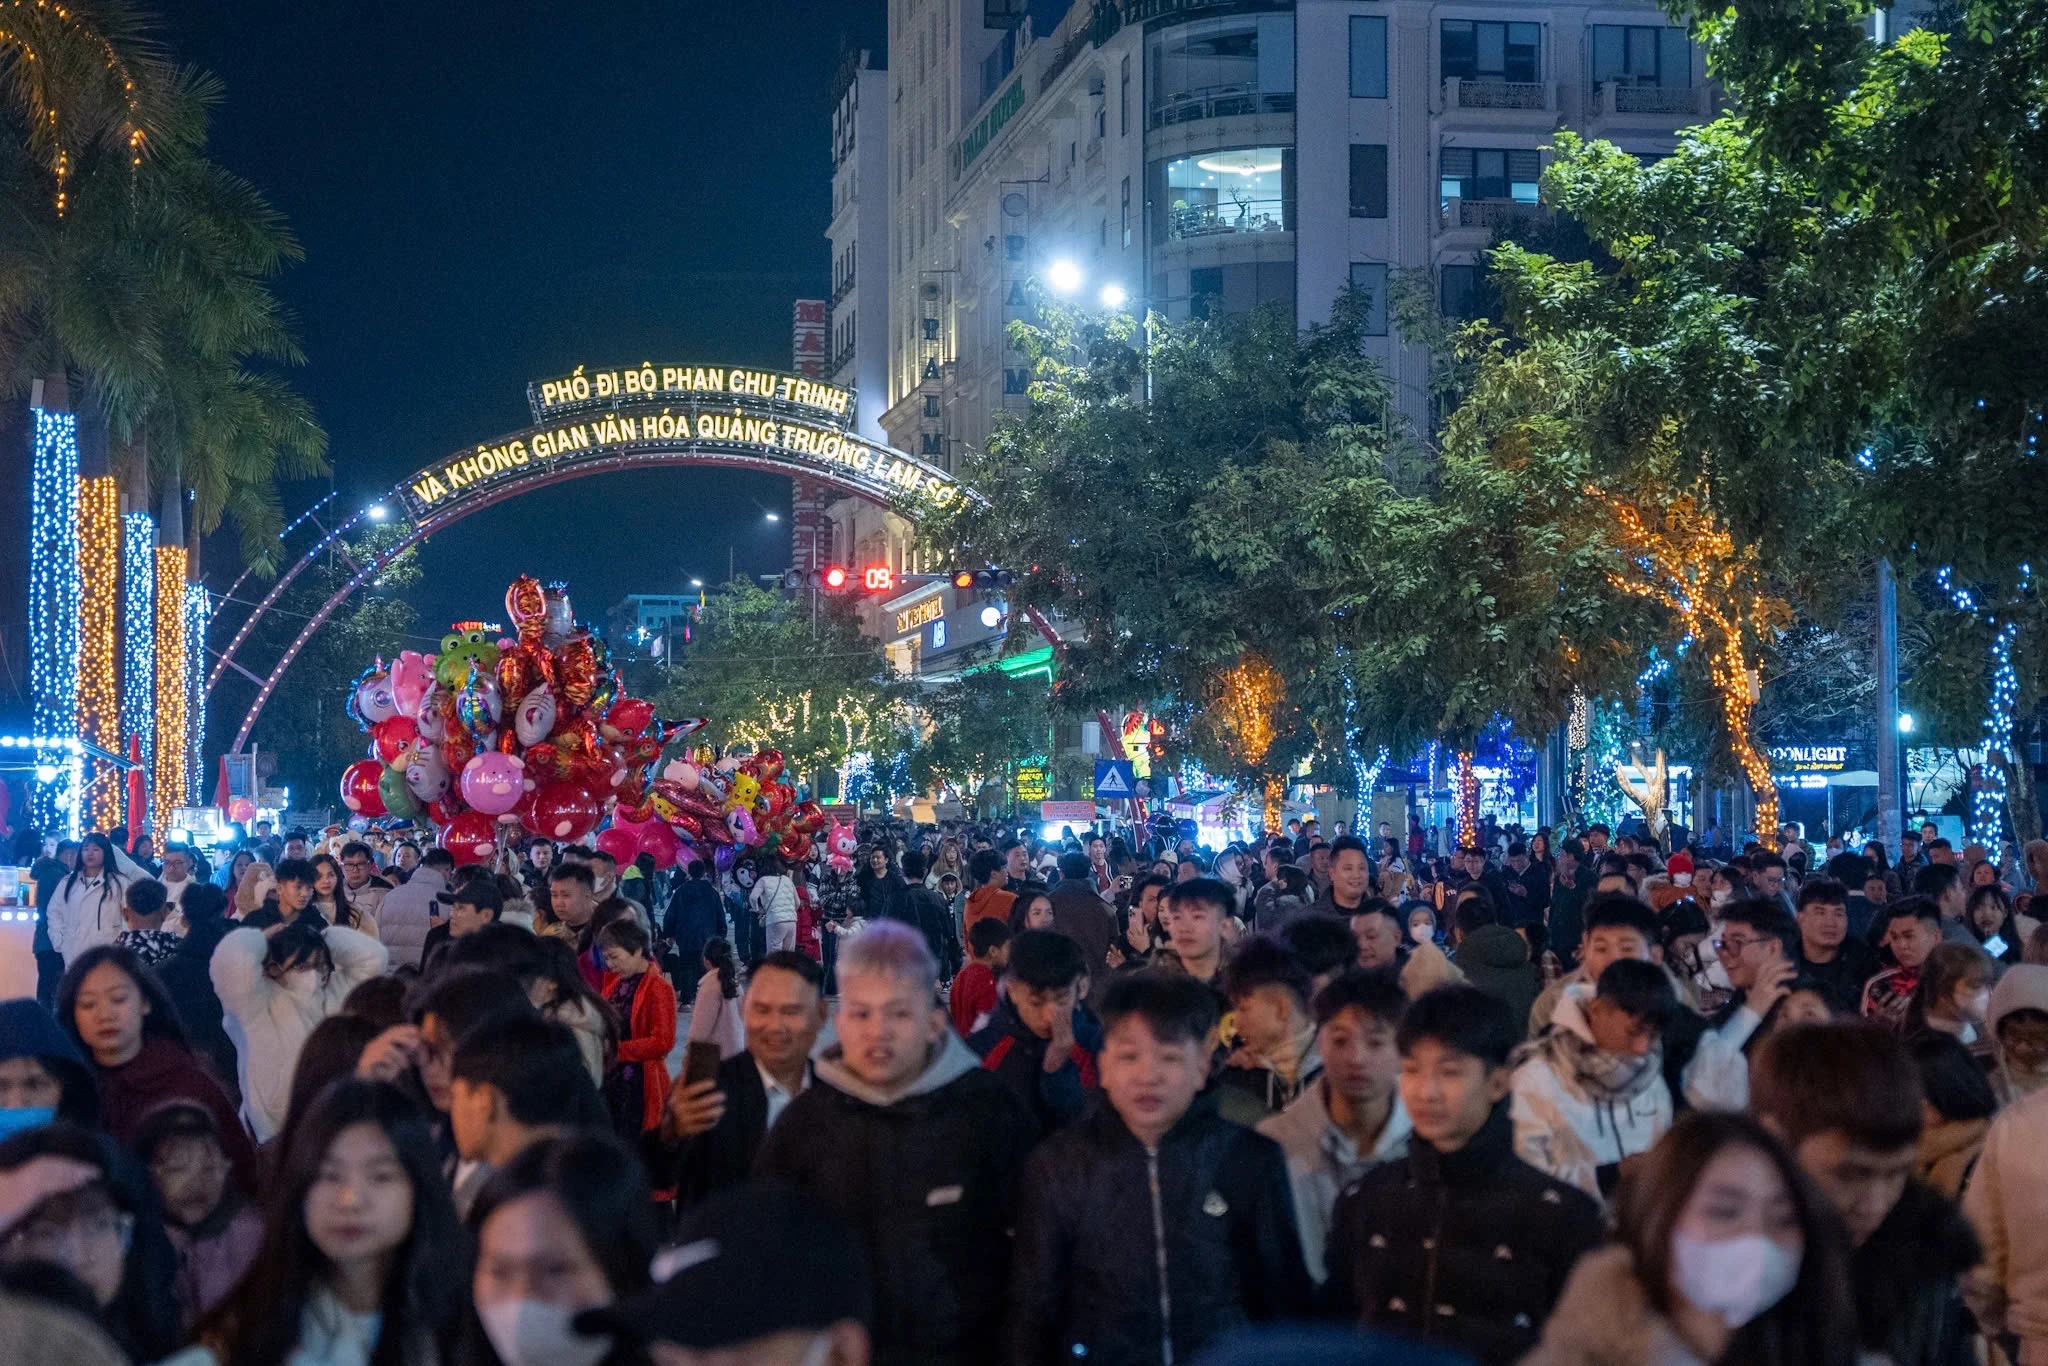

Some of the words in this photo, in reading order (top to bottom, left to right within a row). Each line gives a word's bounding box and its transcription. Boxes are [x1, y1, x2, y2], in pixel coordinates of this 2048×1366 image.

[542, 364, 591, 406] PHỐ
[596, 371, 619, 397] ĐI
[624, 361, 658, 399] BỘ
[662, 367, 724, 392] PHAN
[729, 370, 776, 397] CHU
[782, 378, 848, 414] TRINH
[412, 471, 449, 504] VÀ
[445, 440, 529, 489] KHÔNG
[532, 424, 589, 459] GIAN
[591, 413, 637, 445] VĂN
[641, 408, 690, 439] HÓA
[697, 407, 778, 445] QUẢNG
[782, 426, 871, 471] TRƯỜNG
[873, 453, 923, 492] LAM
[921, 477, 969, 514] SƠ
[866, 568, 890, 590] 09
[1767, 747, 1847, 761] OONLIGHT
